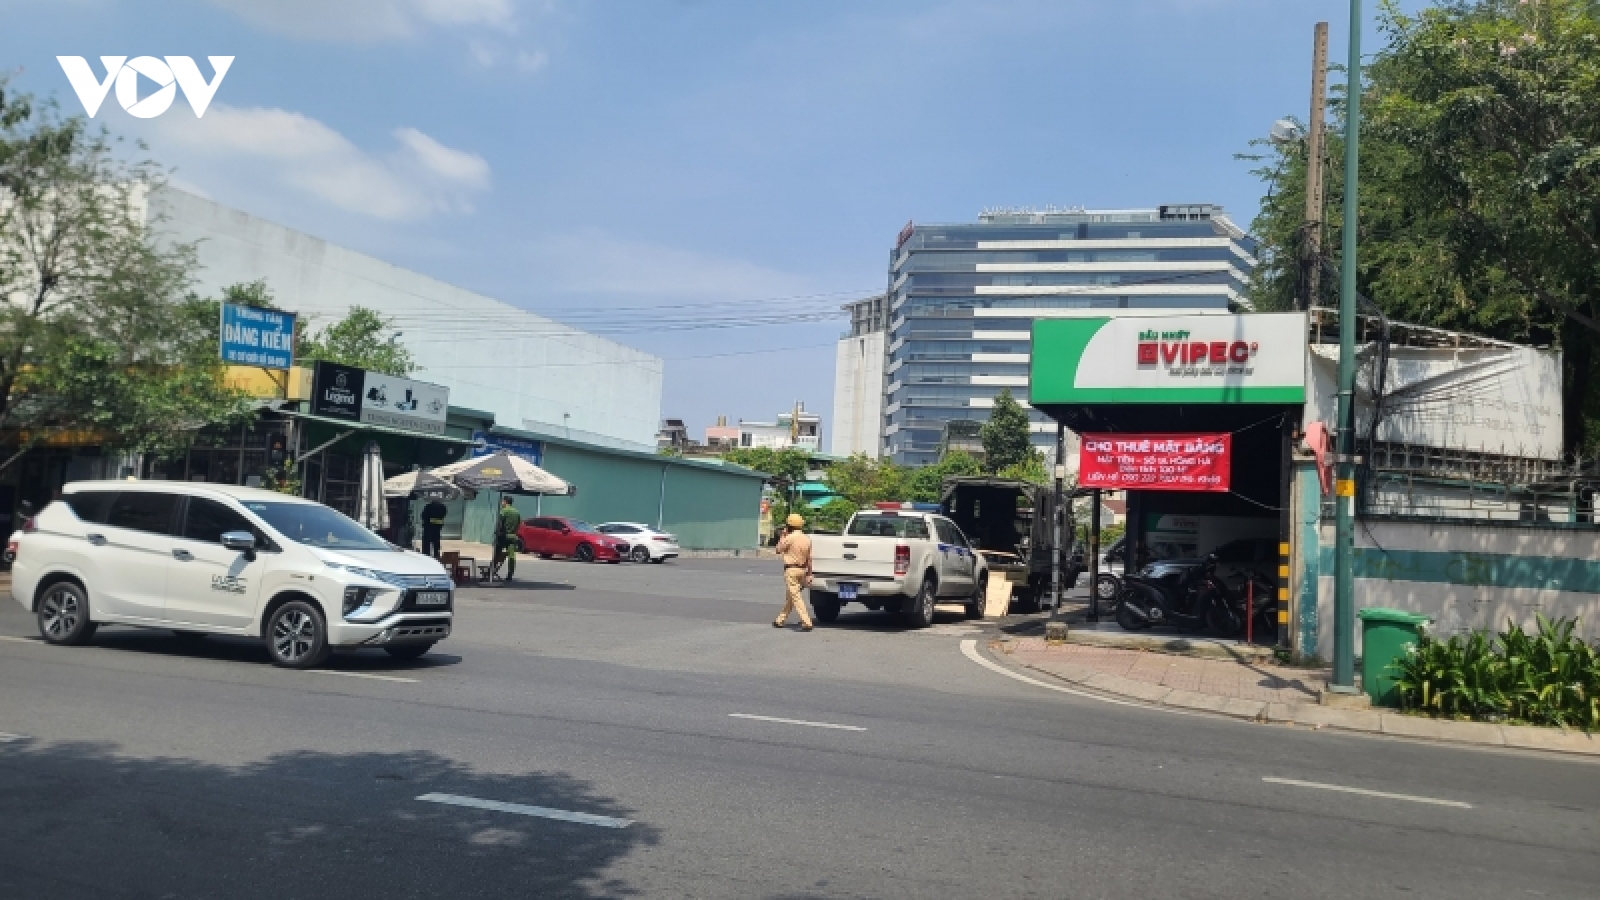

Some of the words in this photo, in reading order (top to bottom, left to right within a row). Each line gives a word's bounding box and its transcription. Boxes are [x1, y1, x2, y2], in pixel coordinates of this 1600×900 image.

[1160, 340, 1249, 365] VIPEC
[325, 388, 355, 405] Legend
[1085, 441, 1112, 452] CHO
[1116, 439, 1150, 453] THUÊ
[1153, 440, 1181, 455] MẶT
